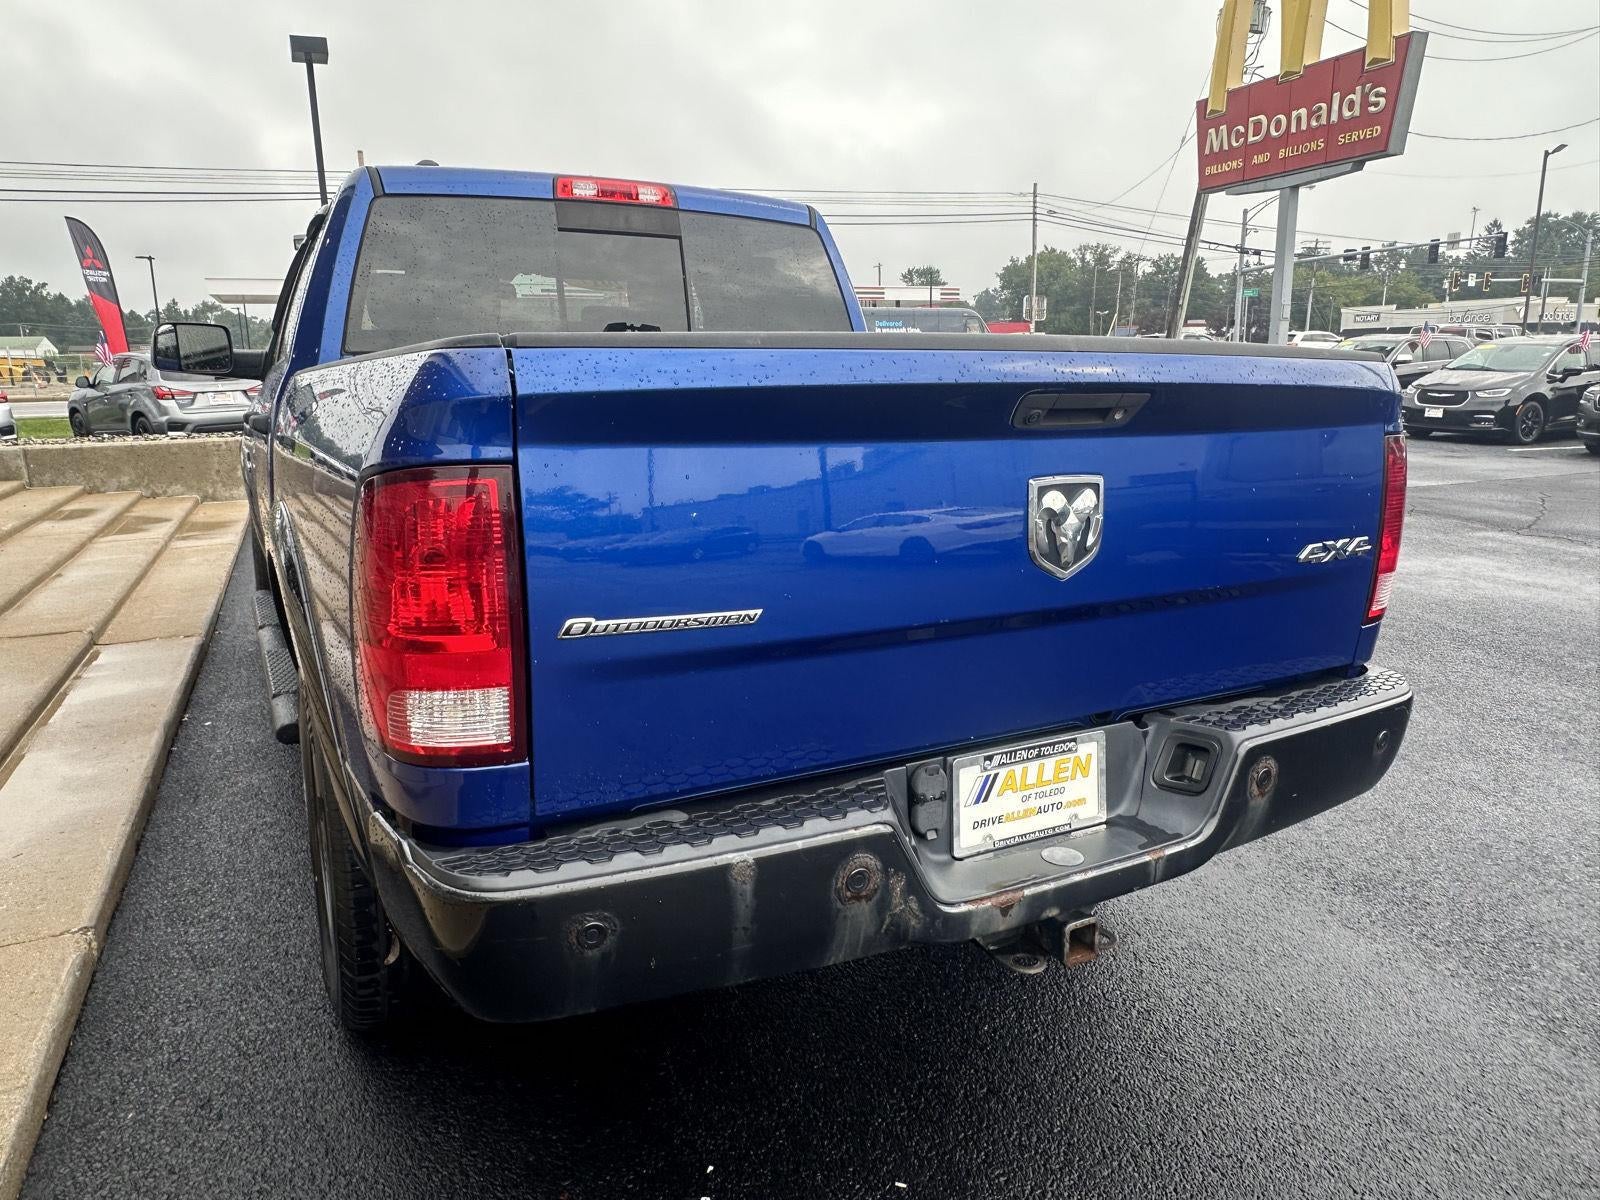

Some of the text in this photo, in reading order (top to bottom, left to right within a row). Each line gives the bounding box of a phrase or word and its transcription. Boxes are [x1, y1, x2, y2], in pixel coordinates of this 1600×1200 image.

[1204, 82, 1387, 156] McDonald's
[1205, 125, 1382, 176] BILLIONS AND BILLIONS SERVED
[1355, 314, 1379, 322] NOTARY
[1000, 742, 1070, 765] ALLEN OF TOLEDO
[997, 753, 1092, 797] ALLEN
[1021, 786, 1066, 803] OF TOLEDO
